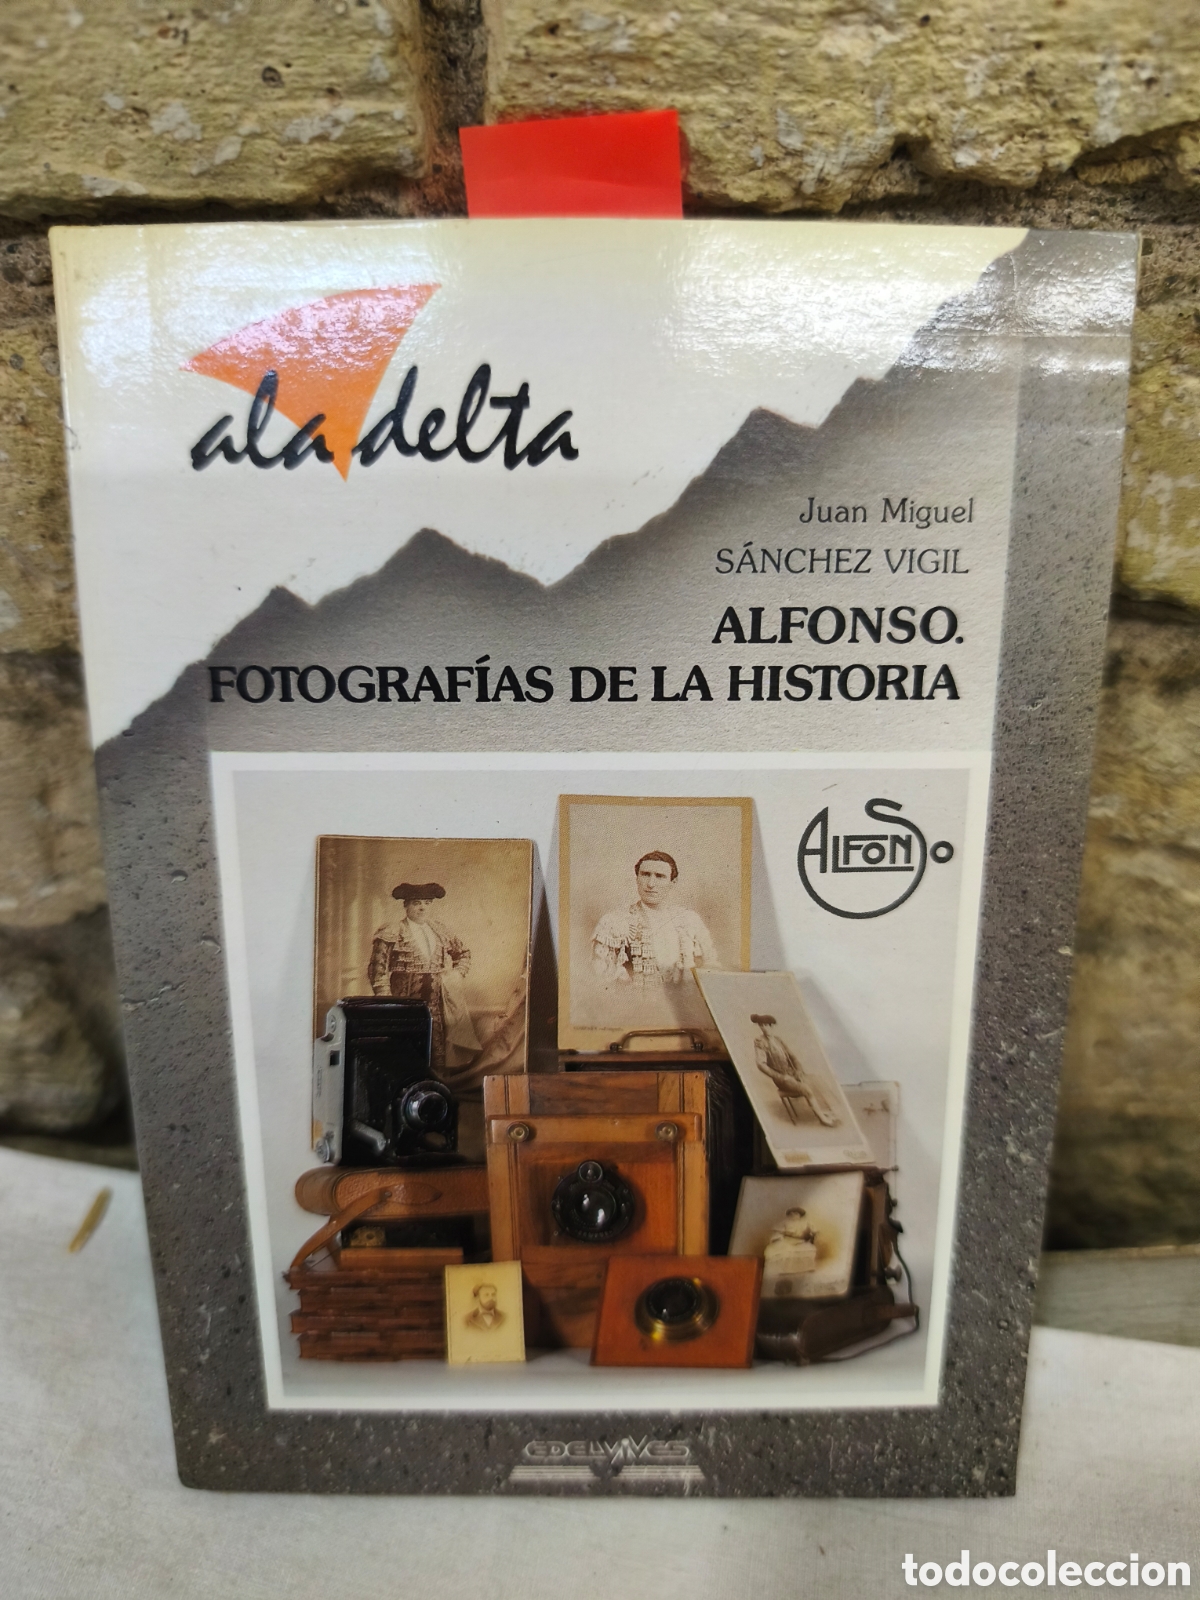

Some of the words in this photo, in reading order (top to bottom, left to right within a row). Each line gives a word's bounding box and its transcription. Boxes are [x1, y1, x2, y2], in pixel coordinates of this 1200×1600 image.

[190, 369, 335, 471] ala
[351, 363, 580, 471] delta
[799, 496, 868, 524] Juan
[880, 497, 974, 530] Miguel
[714, 541, 872, 574] SÁNCHEZ
[883, 548, 970, 574] VIGIL
[711, 605, 965, 645] ALFONSO.
[207, 654, 555, 704] FOTOGRAFÍAS
[568, 665, 639, 703] DE
[650, 664, 714, 702] LA
[726, 663, 961, 702] HISTORIA
[797, 797, 955, 920] ALFONSO
